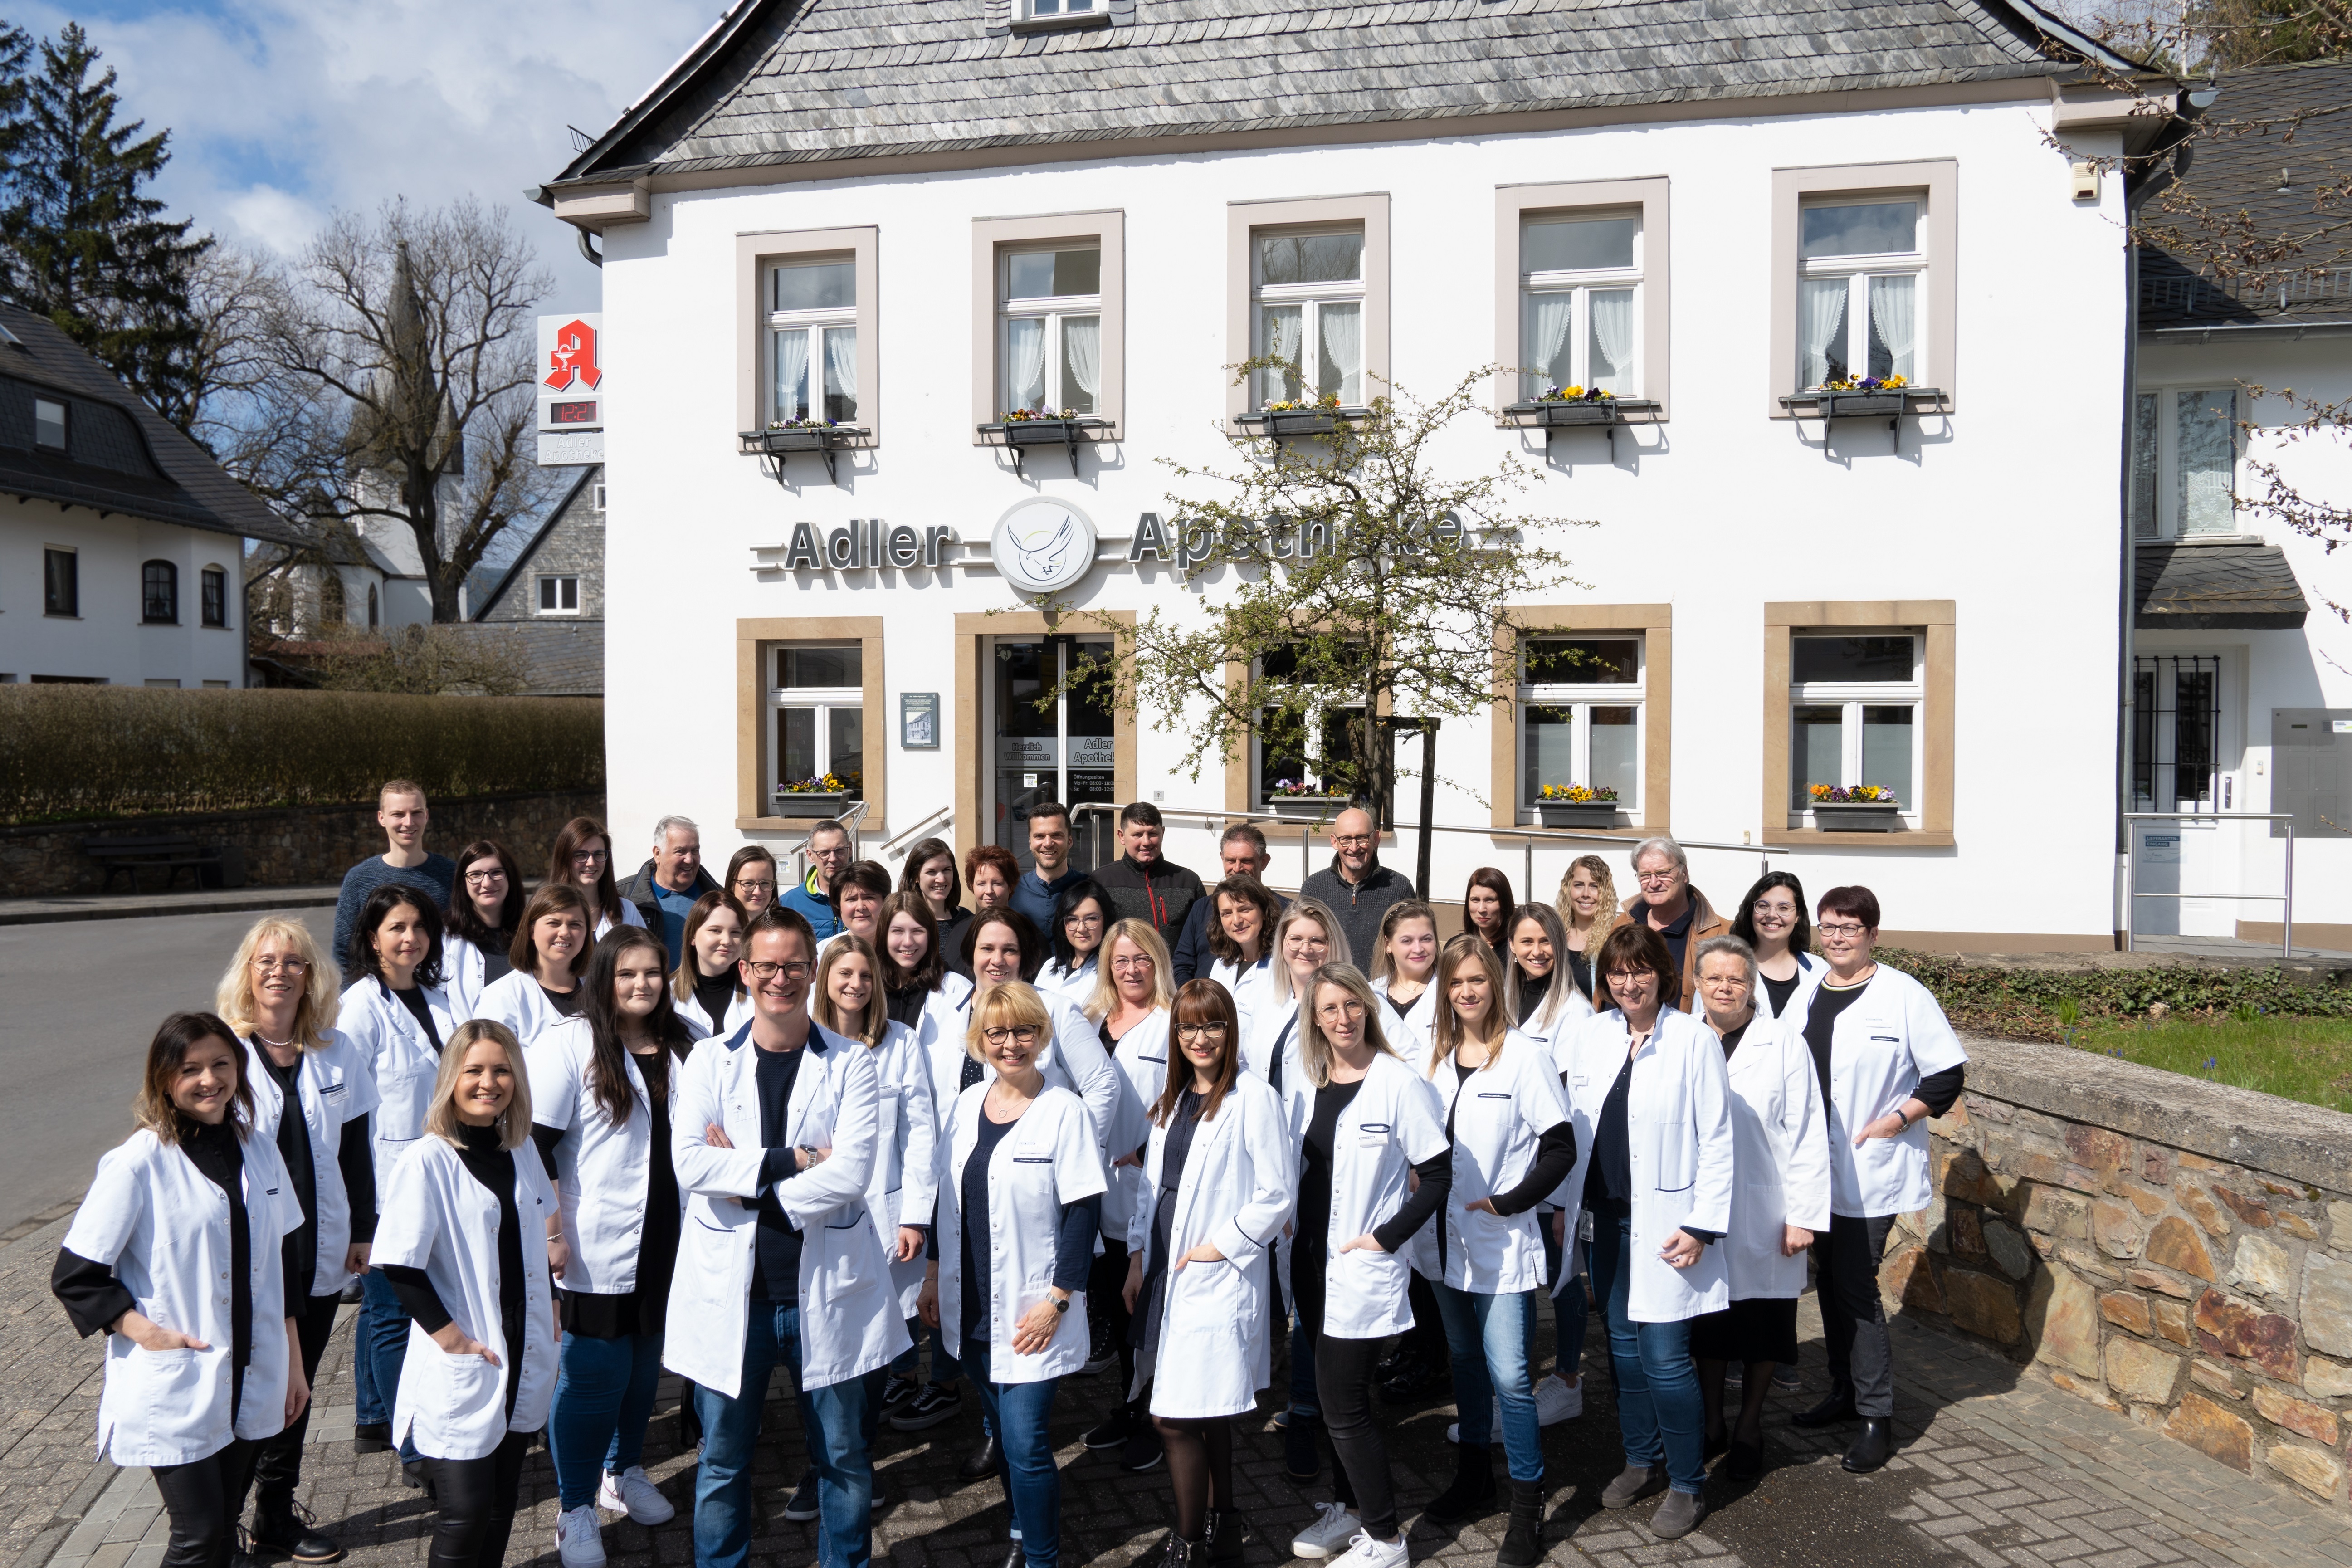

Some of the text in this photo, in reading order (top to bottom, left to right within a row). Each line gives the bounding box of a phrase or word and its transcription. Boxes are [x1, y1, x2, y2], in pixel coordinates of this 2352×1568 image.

[557, 436, 591, 449] Adler
[544, 448, 604, 463] Apotheke
[784, 518, 954, 570] Adler
[1012, 742, 1042, 751] Herzlich
[1084, 738, 1113, 749] Adler
[1004, 752, 1050, 761] Willkommen
